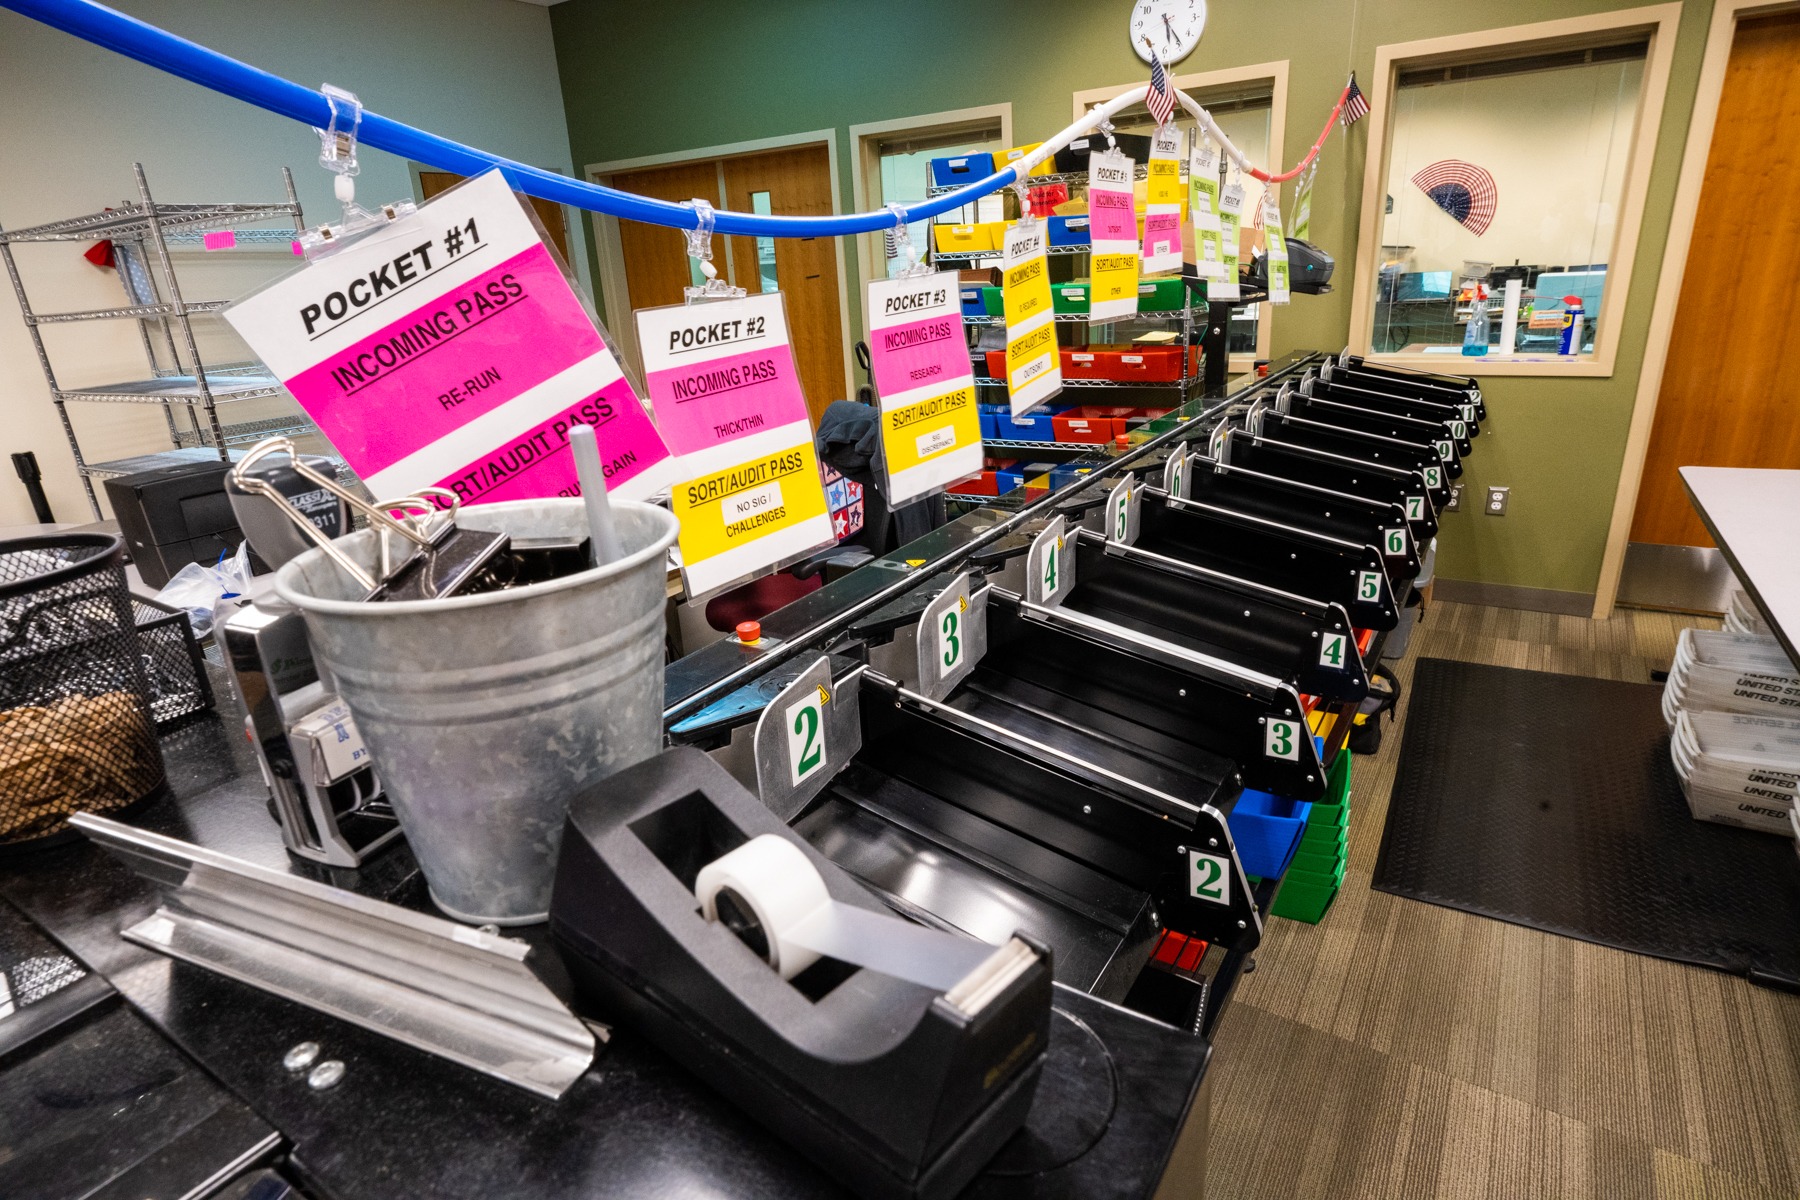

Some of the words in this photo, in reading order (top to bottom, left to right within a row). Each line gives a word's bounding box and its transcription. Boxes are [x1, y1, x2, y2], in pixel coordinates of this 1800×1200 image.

[1143, 6, 1151, 14] 10
[1191, 13, 1196, 22] 3
[1137, 21, 1143, 29] 9
[1162, 46, 1167, 54] 6
[1156, 140, 1172, 151] POCKET
[1097, 167, 1119, 180] POCKET
[1095, 194, 1117, 207] INCOMING
[1117, 197, 1129, 208] PASS
[1011, 238, 1033, 257] POCKET
[1033, 235, 1040, 249] #4
[1009, 266, 1029, 286] INCOMING
[1029, 262, 1041, 278] PASS
[1096, 258, 1122, 270] SORT/AUDIT
[1123, 256, 1134, 268] PASS
[300, 241, 434, 334] POCKET
[444, 217, 482, 258] #1
[885, 291, 931, 313] POCKET
[933, 289, 946, 304] #3
[1110, 287, 1121, 295] OTHER
[331, 311, 458, 393] INCOMING
[460, 273, 524, 324] PASS
[669, 320, 742, 350] POCKET
[746, 316, 766, 336] #2
[884, 327, 928, 349] INCOMING
[929, 322, 951, 340] PASS
[1011, 333, 1038, 358] SORT/AUDIT
[1038, 327, 1051, 344] PASS
[671, 367, 741, 400] INCOMING
[742, 360, 776, 383] PASS
[909, 364, 942, 381] RESEARCH
[1024, 361, 1043, 379] OUTSORT
[437, 367, 503, 412] RE-RUN
[892, 398, 943, 427] SORT/AUDIT
[945, 391, 966, 410] PASS
[713, 413, 765, 439] THICK/THIN
[1439, 442, 1450, 460] 9
[601, 450, 637, 478] GAIN
[688, 463, 767, 504] SORT/AUDIT
[770, 452, 803, 476] PASS
[1426, 468, 1438, 486] 8
[736, 501, 750, 513] NO
[752, 495, 767, 508] SIG
[1408, 498, 1421, 518] 7
[726, 506, 787, 538] CHALLENGES
[1117, 498, 1126, 540] 5
[1387, 530, 1402, 553] 6
[1044, 545, 1057, 592] 4
[1361, 574, 1377, 600] 5
[942, 611, 960, 667] 3
[1323, 637, 1342, 665] 4
[1733, 688, 1779, 703] UNITED
[1736, 678, 1783, 693] UNITED
[794, 706, 821, 777] 2
[1271, 722, 1293, 756] 3
[1747, 774, 1798, 789] UNITED
[1743, 786, 1793, 801] UNITED
[1738, 803, 1787, 819] UNITED
[1196, 857, 1222, 900] 2
